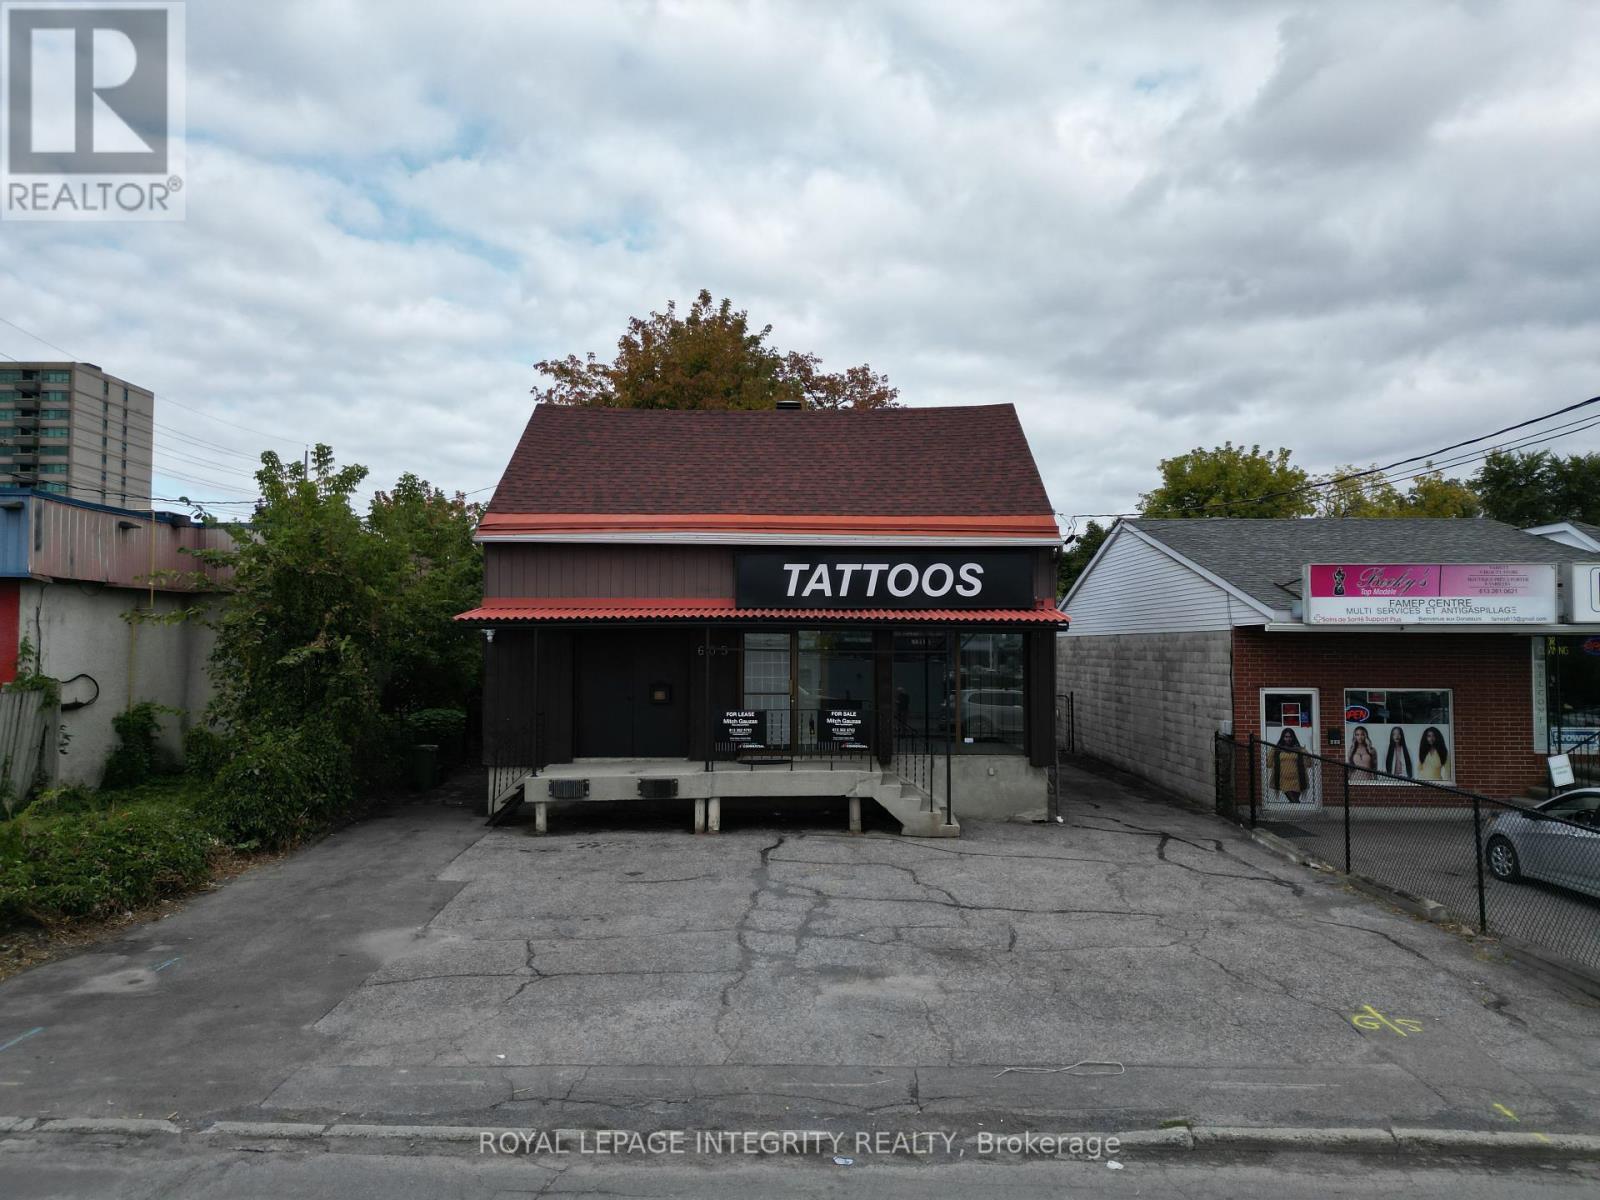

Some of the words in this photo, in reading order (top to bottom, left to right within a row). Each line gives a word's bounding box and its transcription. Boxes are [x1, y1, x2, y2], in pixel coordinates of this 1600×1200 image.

[783, 563, 984, 597] TATTOOS
[1389, 599, 1426, 608] FAMEP
[1428, 599, 1472, 608] CENTRE
[1346, 607, 1372, 615] MULTI
[1377, 607, 1421, 615] SERVICES
[1441, 606, 1517, 614] ANTIGASPILLAGE
